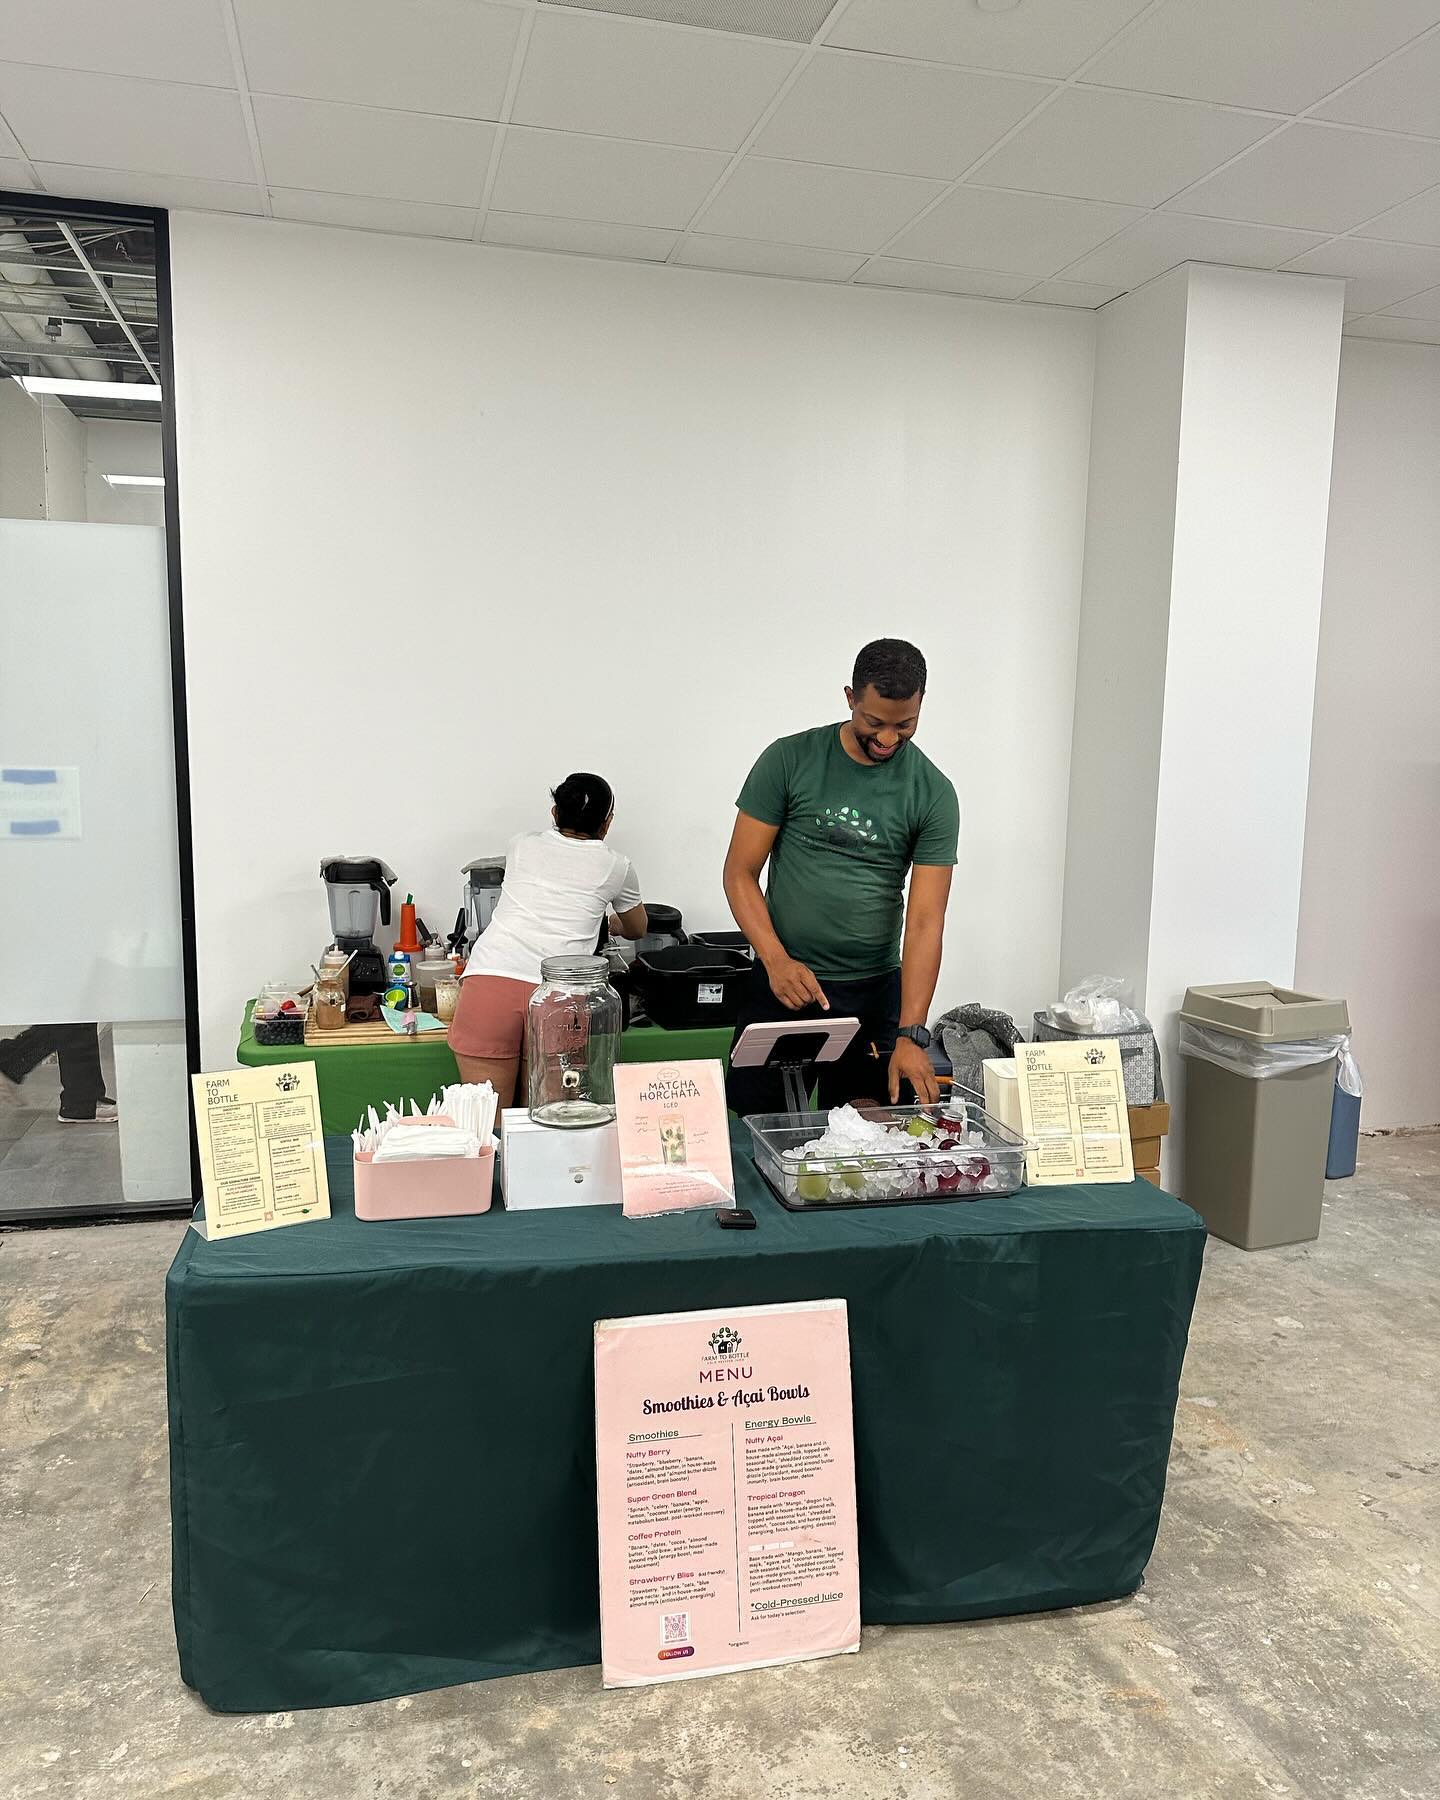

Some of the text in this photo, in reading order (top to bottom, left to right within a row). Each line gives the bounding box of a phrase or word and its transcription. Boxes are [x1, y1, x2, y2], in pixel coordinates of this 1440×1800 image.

[1027, 1064, 1053, 1072] BOTTLE
[206, 1078, 230, 1088] FARM
[648, 1080, 696, 1091] MATCHA
[208, 1088, 218, 1097] TO
[640, 1088, 700, 1102] HORCHATA
[208, 1094, 239, 1105] BOTTLE
[699, 1366, 753, 1384] MENU
[642, 1384, 810, 1415] Smoothies & Açai Bowls
[745, 1415, 811, 1429] Energy Bowls
[628, 1430, 679, 1442] Smoothies
[767, 1435, 783, 1443] Açai
[626, 1451, 646, 1459] Nutty
[677, 1489, 697, 1498] Blend
[747, 1493, 777, 1502] Tropical
[671, 1512, 702, 1521] post-workout
[654, 1529, 681, 1538] Protein
[629, 1575, 675, 1586] Strawberry
[677, 1587, 706, 1595] house-made
[820, 1592, 844, 1603] Juice
